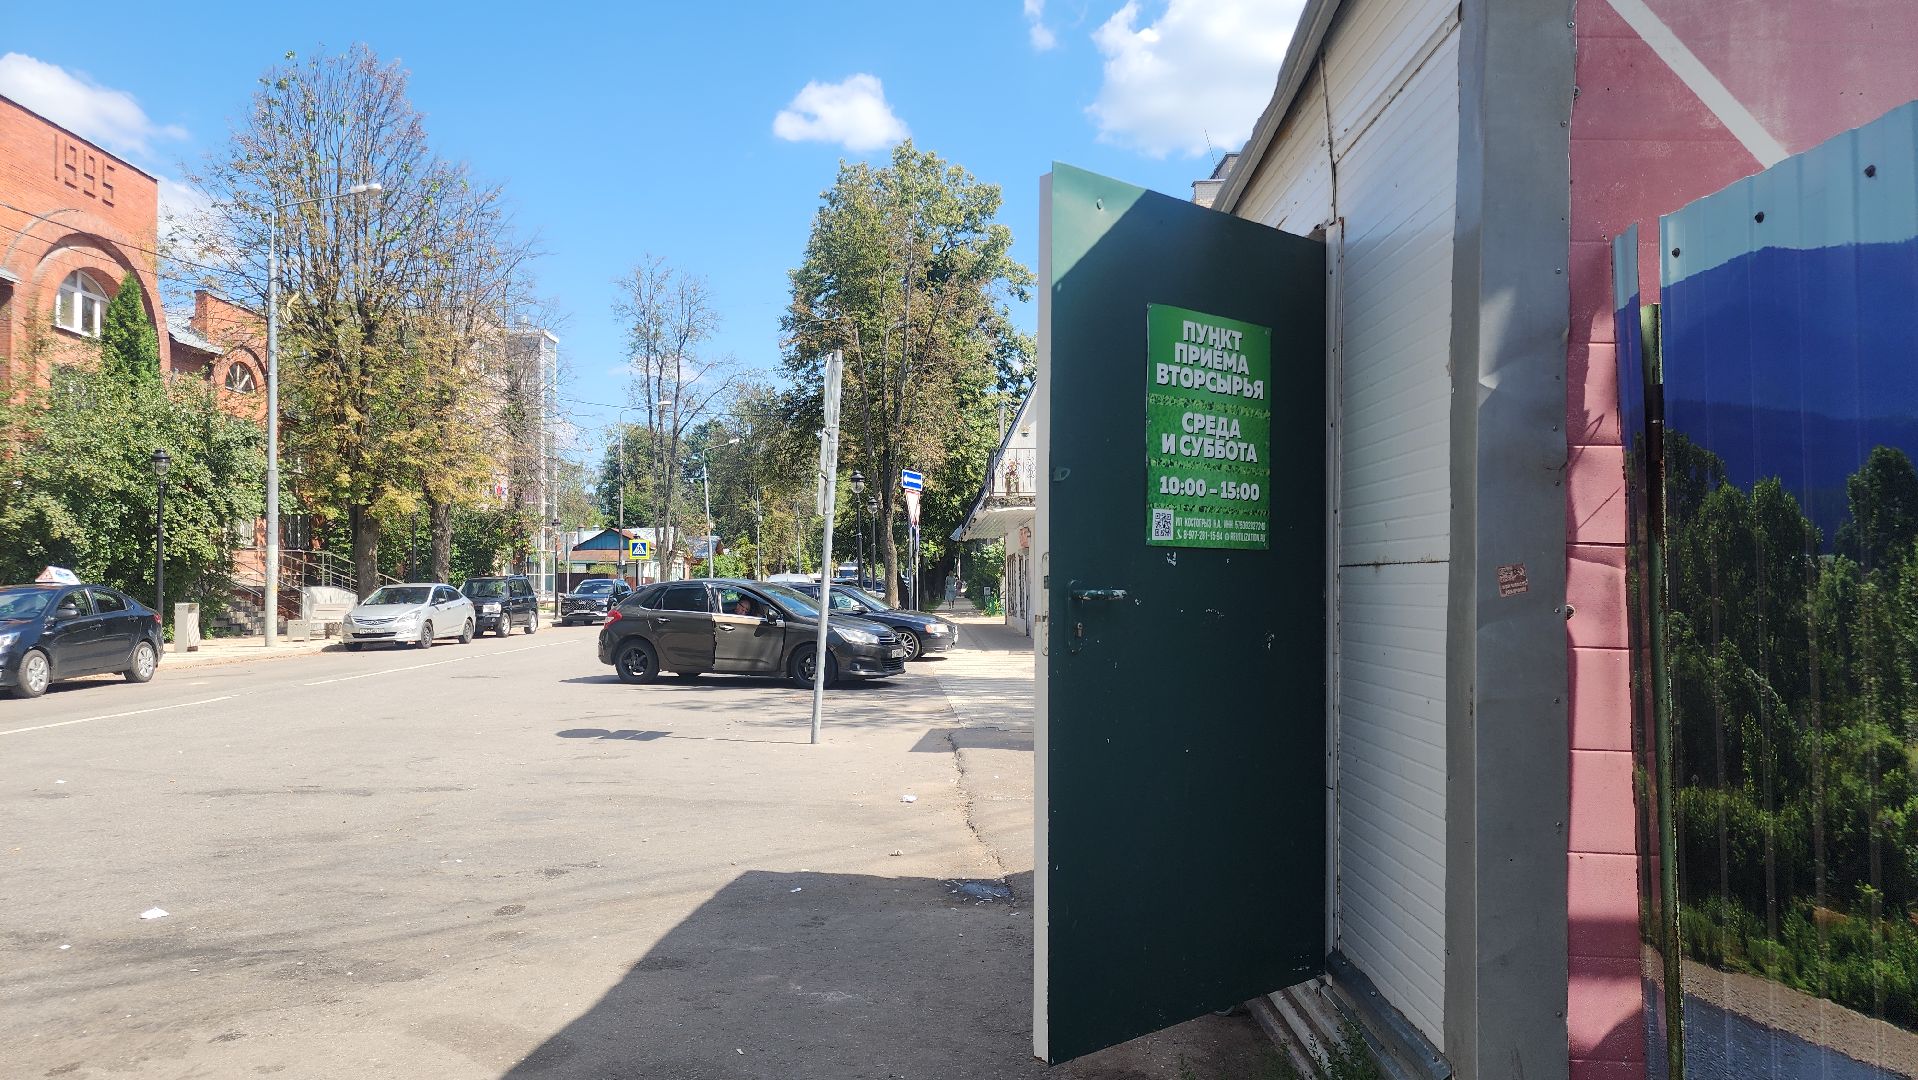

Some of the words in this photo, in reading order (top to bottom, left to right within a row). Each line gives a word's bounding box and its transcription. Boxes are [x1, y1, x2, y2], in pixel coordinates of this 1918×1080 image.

[54, 133, 116, 208] 1995
[1183, 320, 1242, 351] ПУНКТ
[1175, 342, 1249, 375] ПРИЁМА
[1156, 362, 1264, 400] ВТОРСЫРЬЯ
[1181, 411, 1242, 440] СРЕДА
[1161, 433, 1176, 454] И
[1180, 435, 1258, 463] СУББОТА
[1160, 475, 1207, 497] 10:00
[1220, 480, 1260, 501] 15:00
